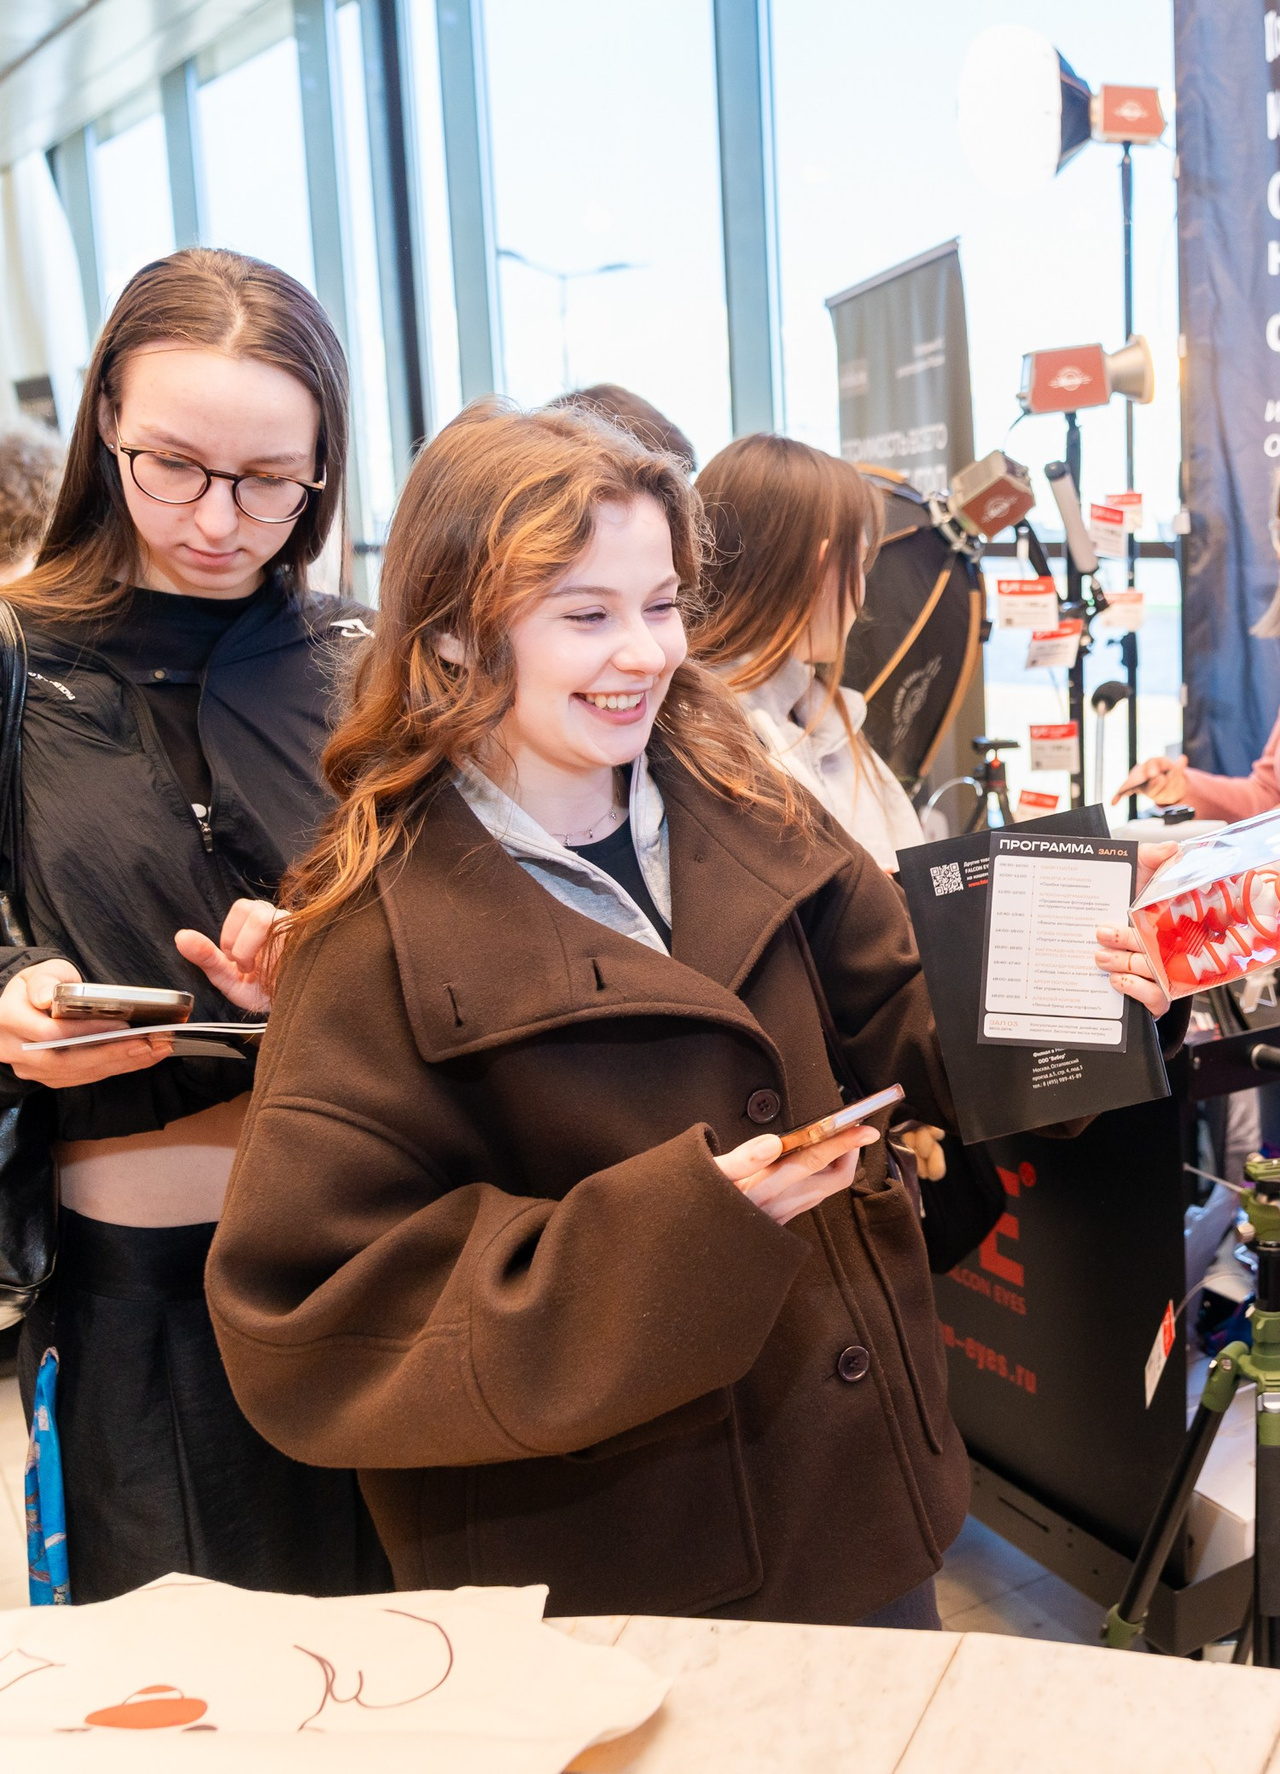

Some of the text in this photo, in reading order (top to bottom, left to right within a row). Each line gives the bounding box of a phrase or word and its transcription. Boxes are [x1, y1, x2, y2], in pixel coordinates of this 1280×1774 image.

[999, 839, 1094, 855] ПРОГРАММА
[1098, 848, 1116, 856] ЗАЛ
[942, 1323, 1037, 1394] n-eyes.ru
